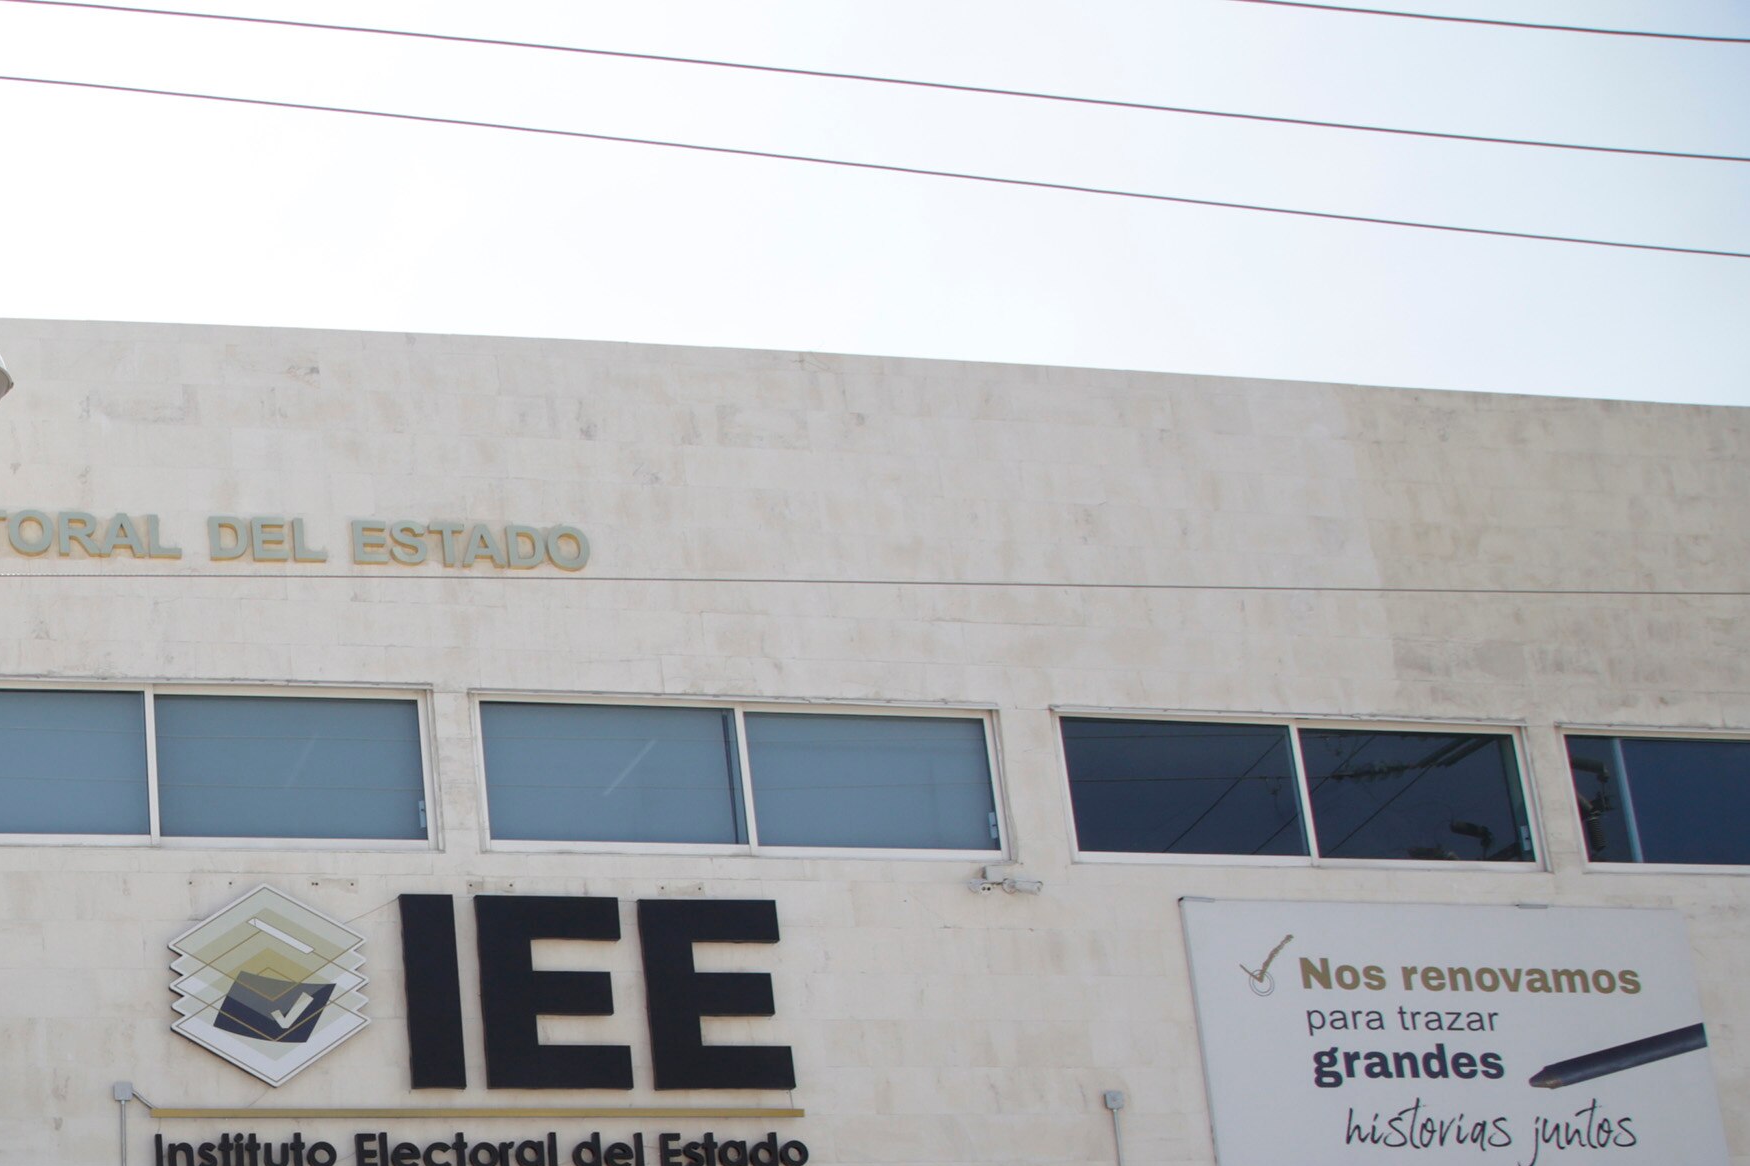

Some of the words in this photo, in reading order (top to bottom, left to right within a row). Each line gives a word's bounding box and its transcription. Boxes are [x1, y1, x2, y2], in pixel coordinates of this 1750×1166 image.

[207, 515, 329, 562] DEL
[350, 519, 591, 572] ESTADO
[398, 893, 796, 1090] IEE
[1299, 957, 1387, 991] Nos
[1401, 962, 1642, 995] renovamos
[1306, 1005, 1386, 1036] para
[1397, 1004, 1499, 1032] trazar
[1313, 1043, 1505, 1088] grandes
[1345, 1097, 1512, 1150] historias
